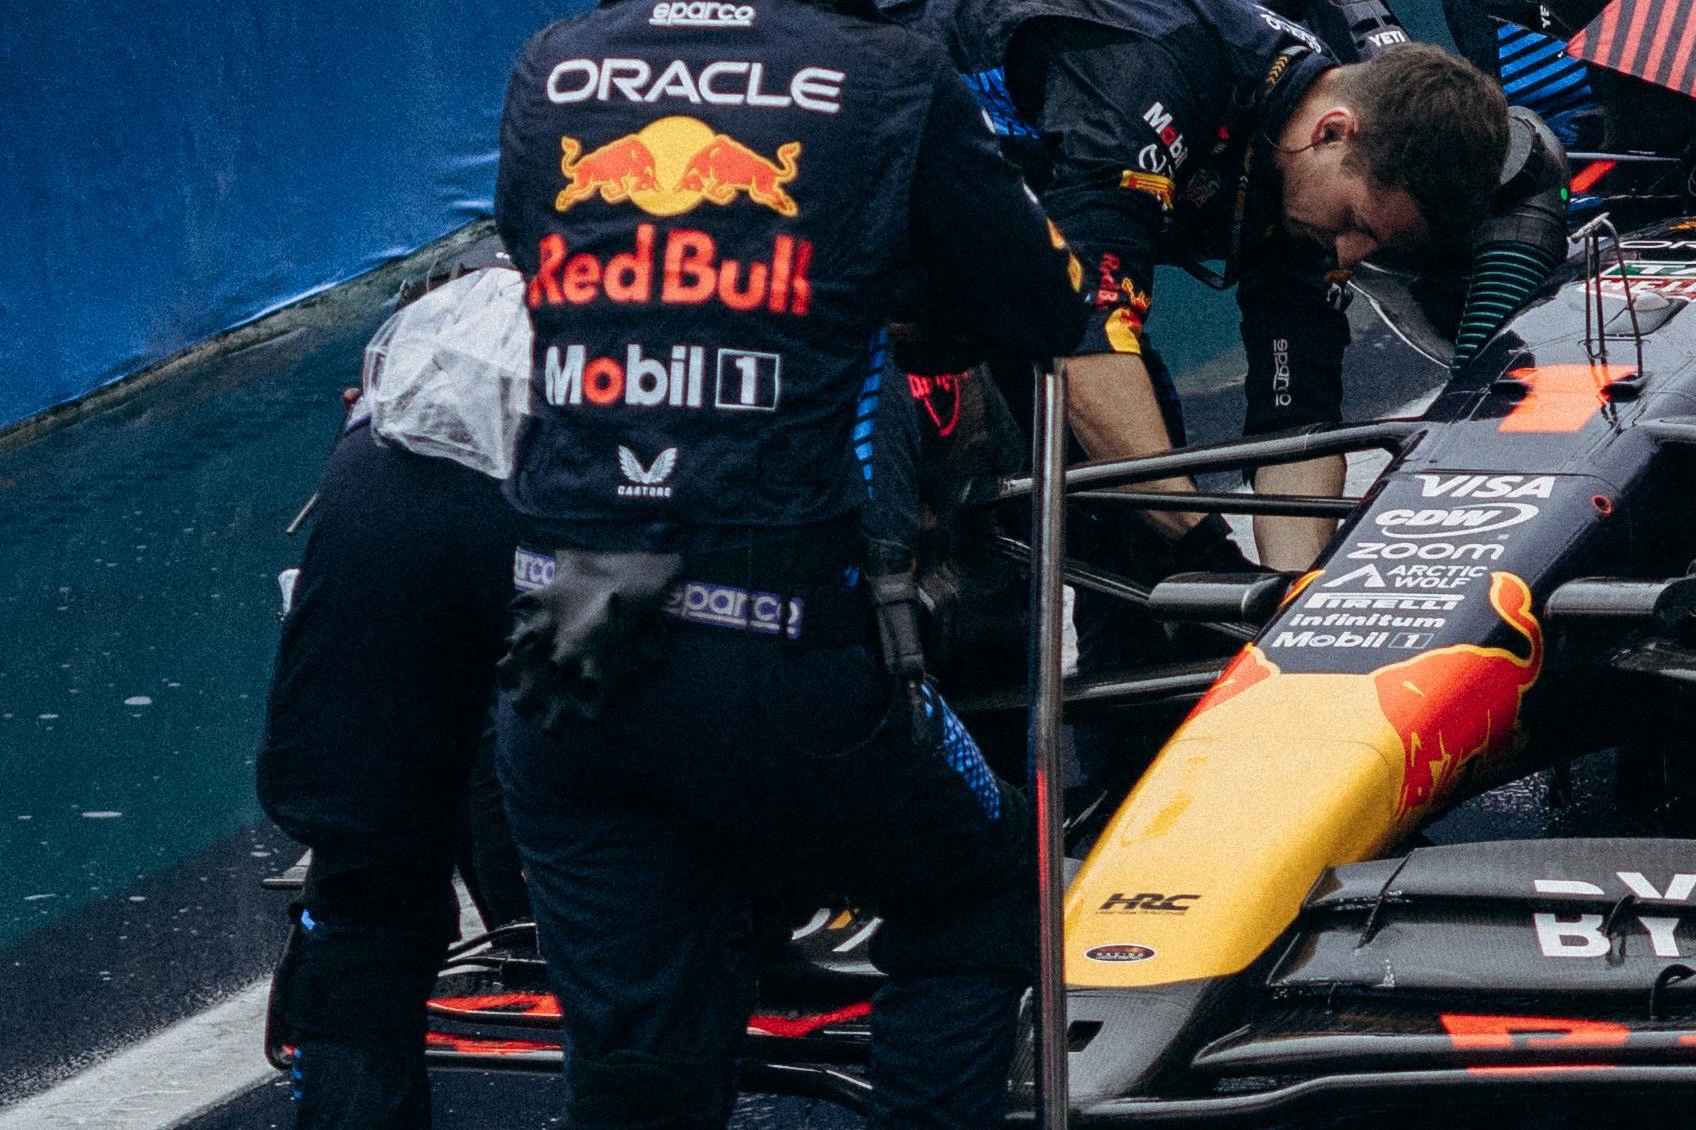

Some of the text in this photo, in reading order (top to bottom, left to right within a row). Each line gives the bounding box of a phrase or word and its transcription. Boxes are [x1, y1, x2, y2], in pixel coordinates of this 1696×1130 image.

[1368, 30, 1406, 48] YETI
[546, 58, 846, 114] ORACLE
[529, 224, 813, 316] Red Bull
[545, 345, 704, 408] Mobil
[1413, 474, 1556, 499] VISA
[1374, 508, 1503, 527] CDW
[1346, 542, 1505, 561] zoom
[1386, 564, 1488, 578] ARCTIC
[1393, 576, 1473, 589] WOLF
[1303, 592, 1466, 610] PIRELLI
[1271, 631, 1390, 648] Mobil
[1099, 892, 1203, 911] HRC
